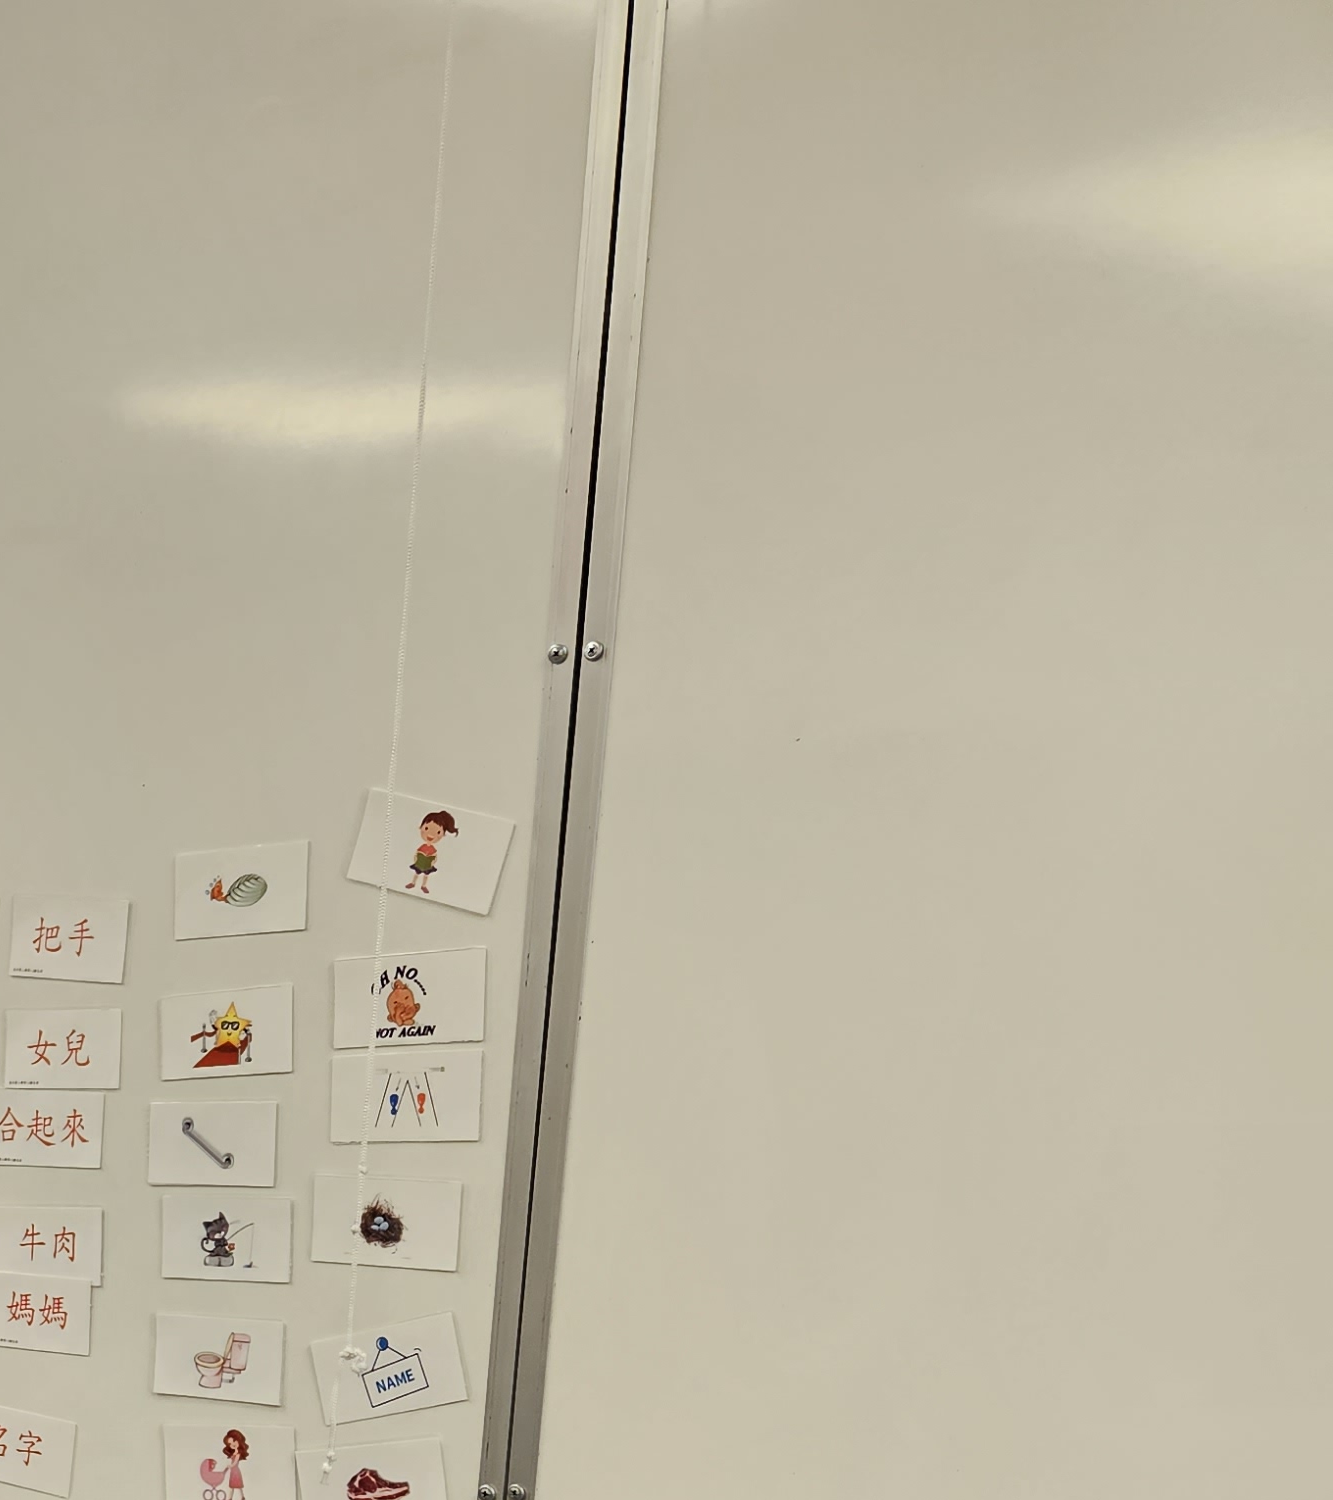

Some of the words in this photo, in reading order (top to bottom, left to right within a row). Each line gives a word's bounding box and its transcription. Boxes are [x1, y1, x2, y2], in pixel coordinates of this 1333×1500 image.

[33, 917, 96, 957] 把手
[26, 1029, 90, 1069] 女兒
[398, 1025, 436, 1037] AGAIN
[19, 1224, 77, 1262] 牛肉
[6, 1291, 69, 1330] 媽媽
[375, 1366, 416, 1393] NAME
